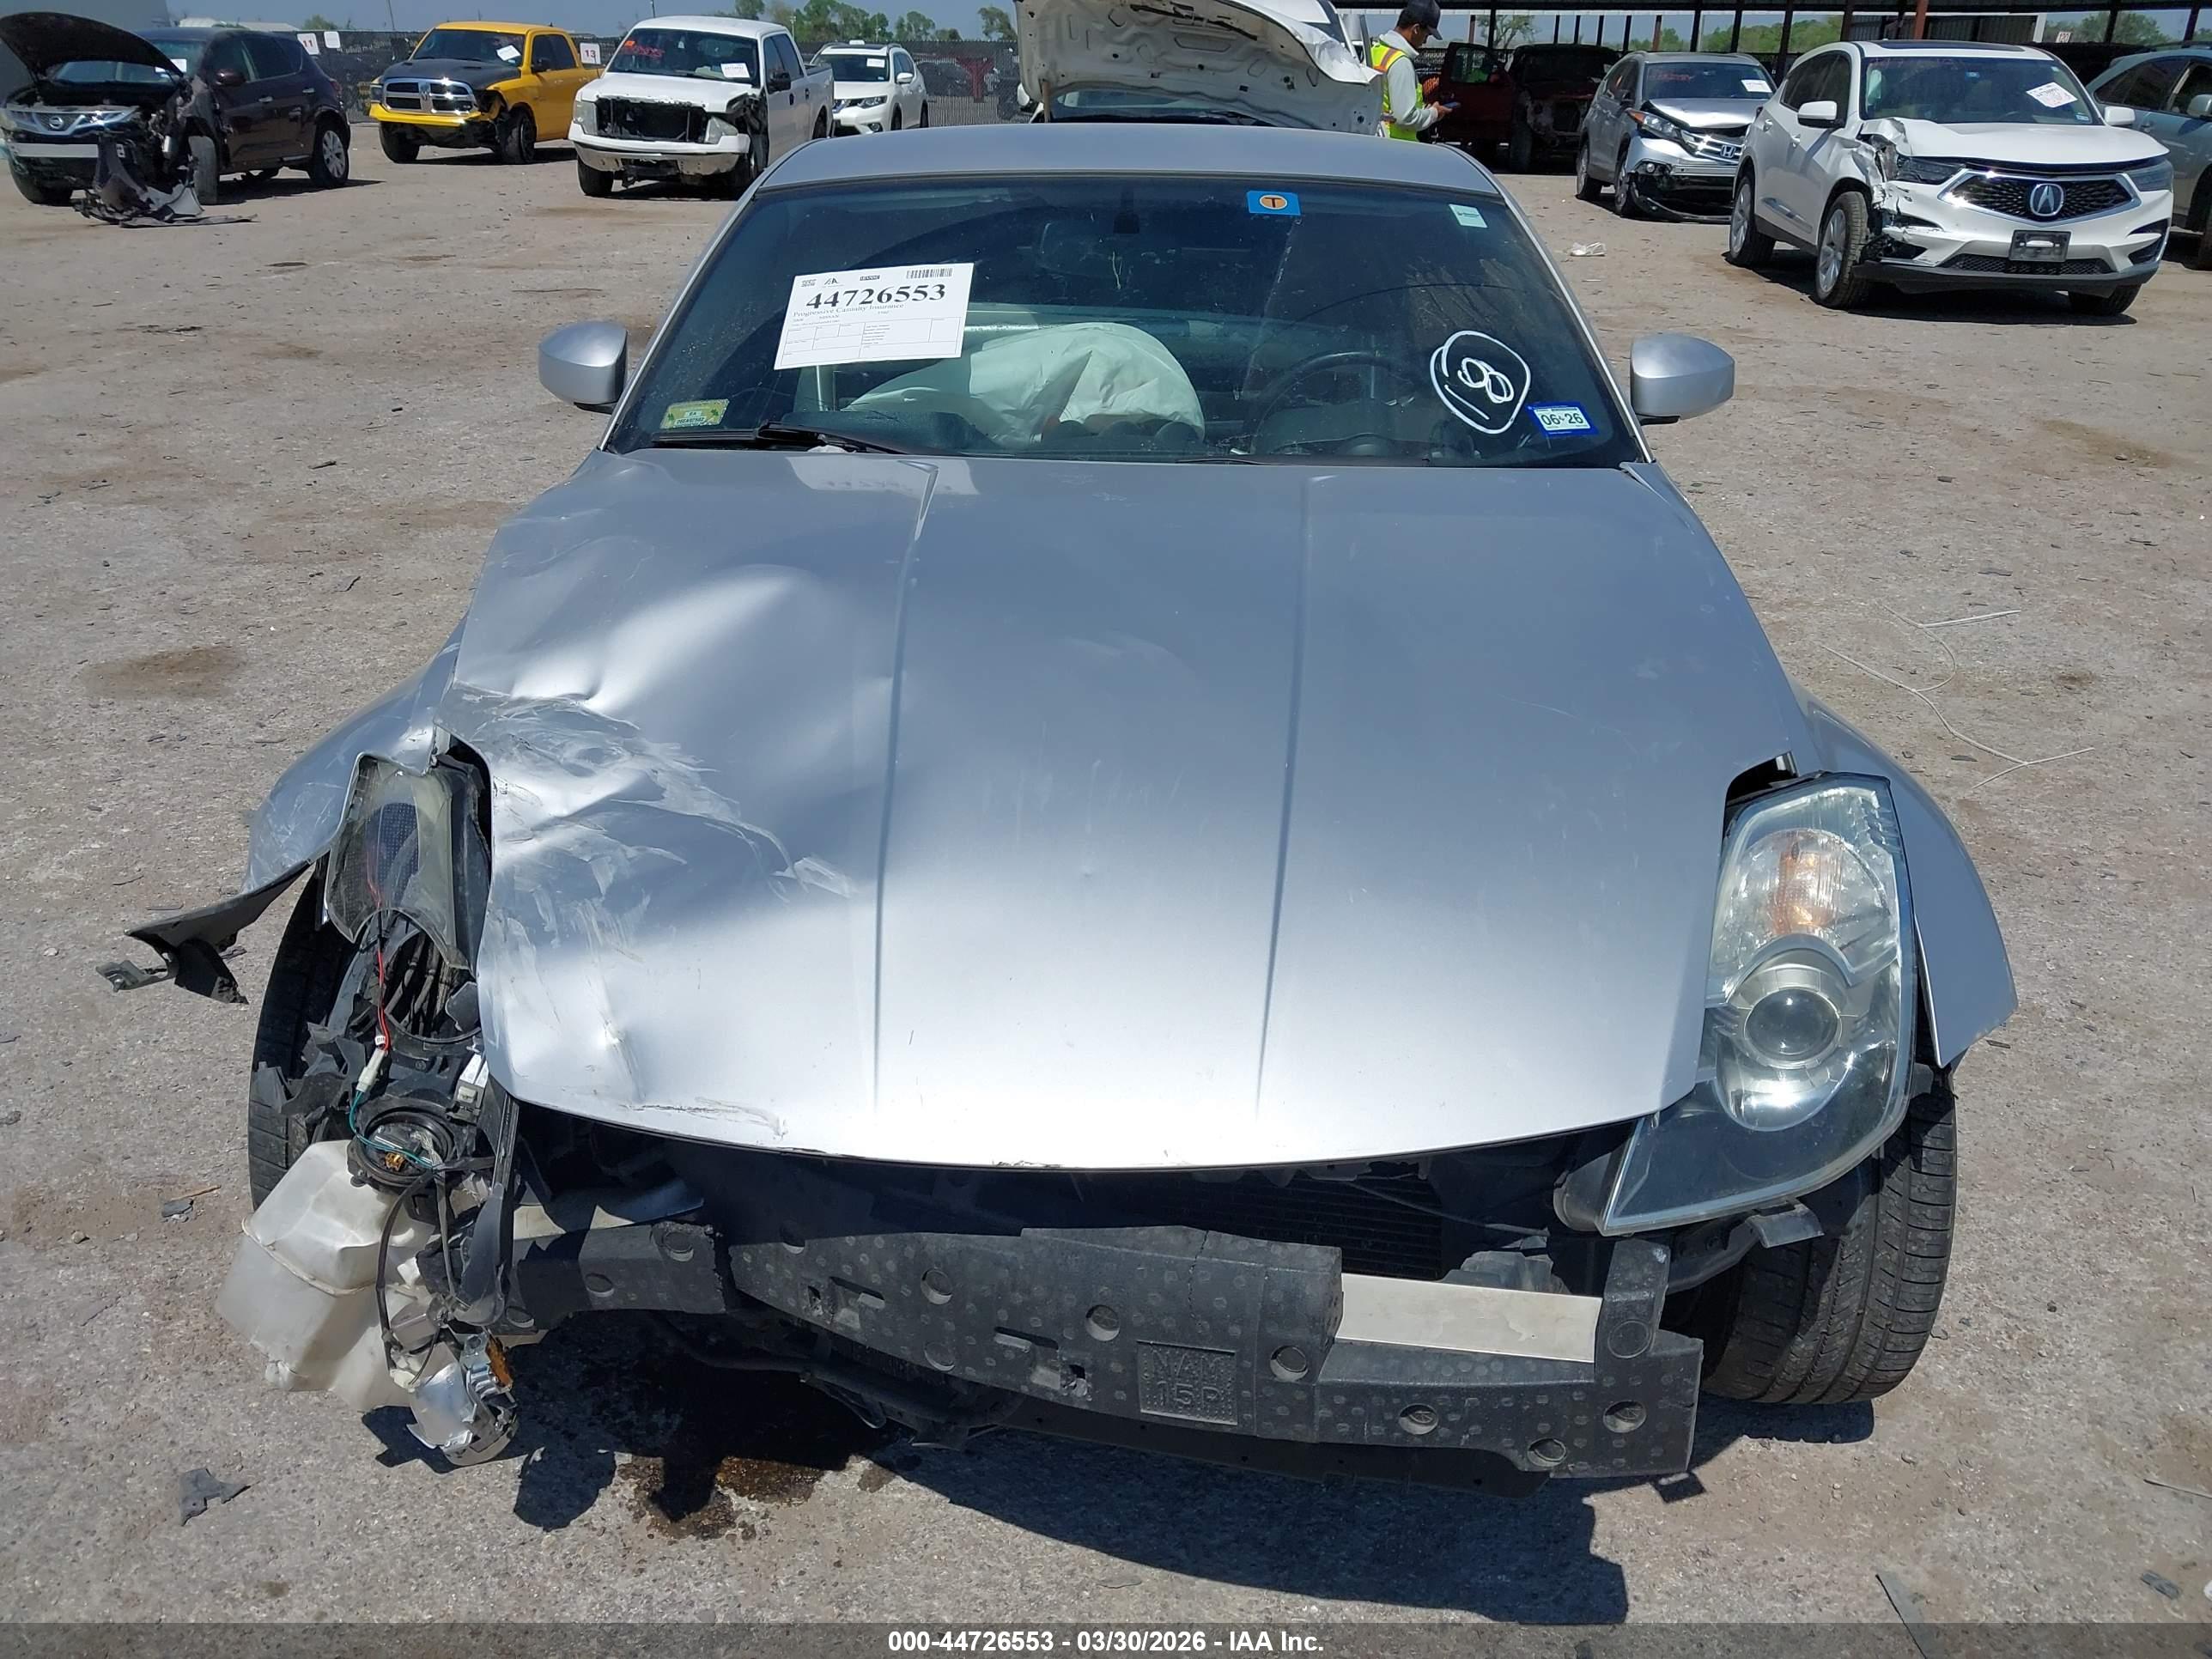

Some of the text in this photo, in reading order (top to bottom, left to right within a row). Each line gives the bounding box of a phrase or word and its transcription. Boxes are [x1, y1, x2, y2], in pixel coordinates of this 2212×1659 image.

[584, 49, 596, 58] 13
[805, 283, 946, 309] 44726553
[793, 307, 835, 317] Progressive
